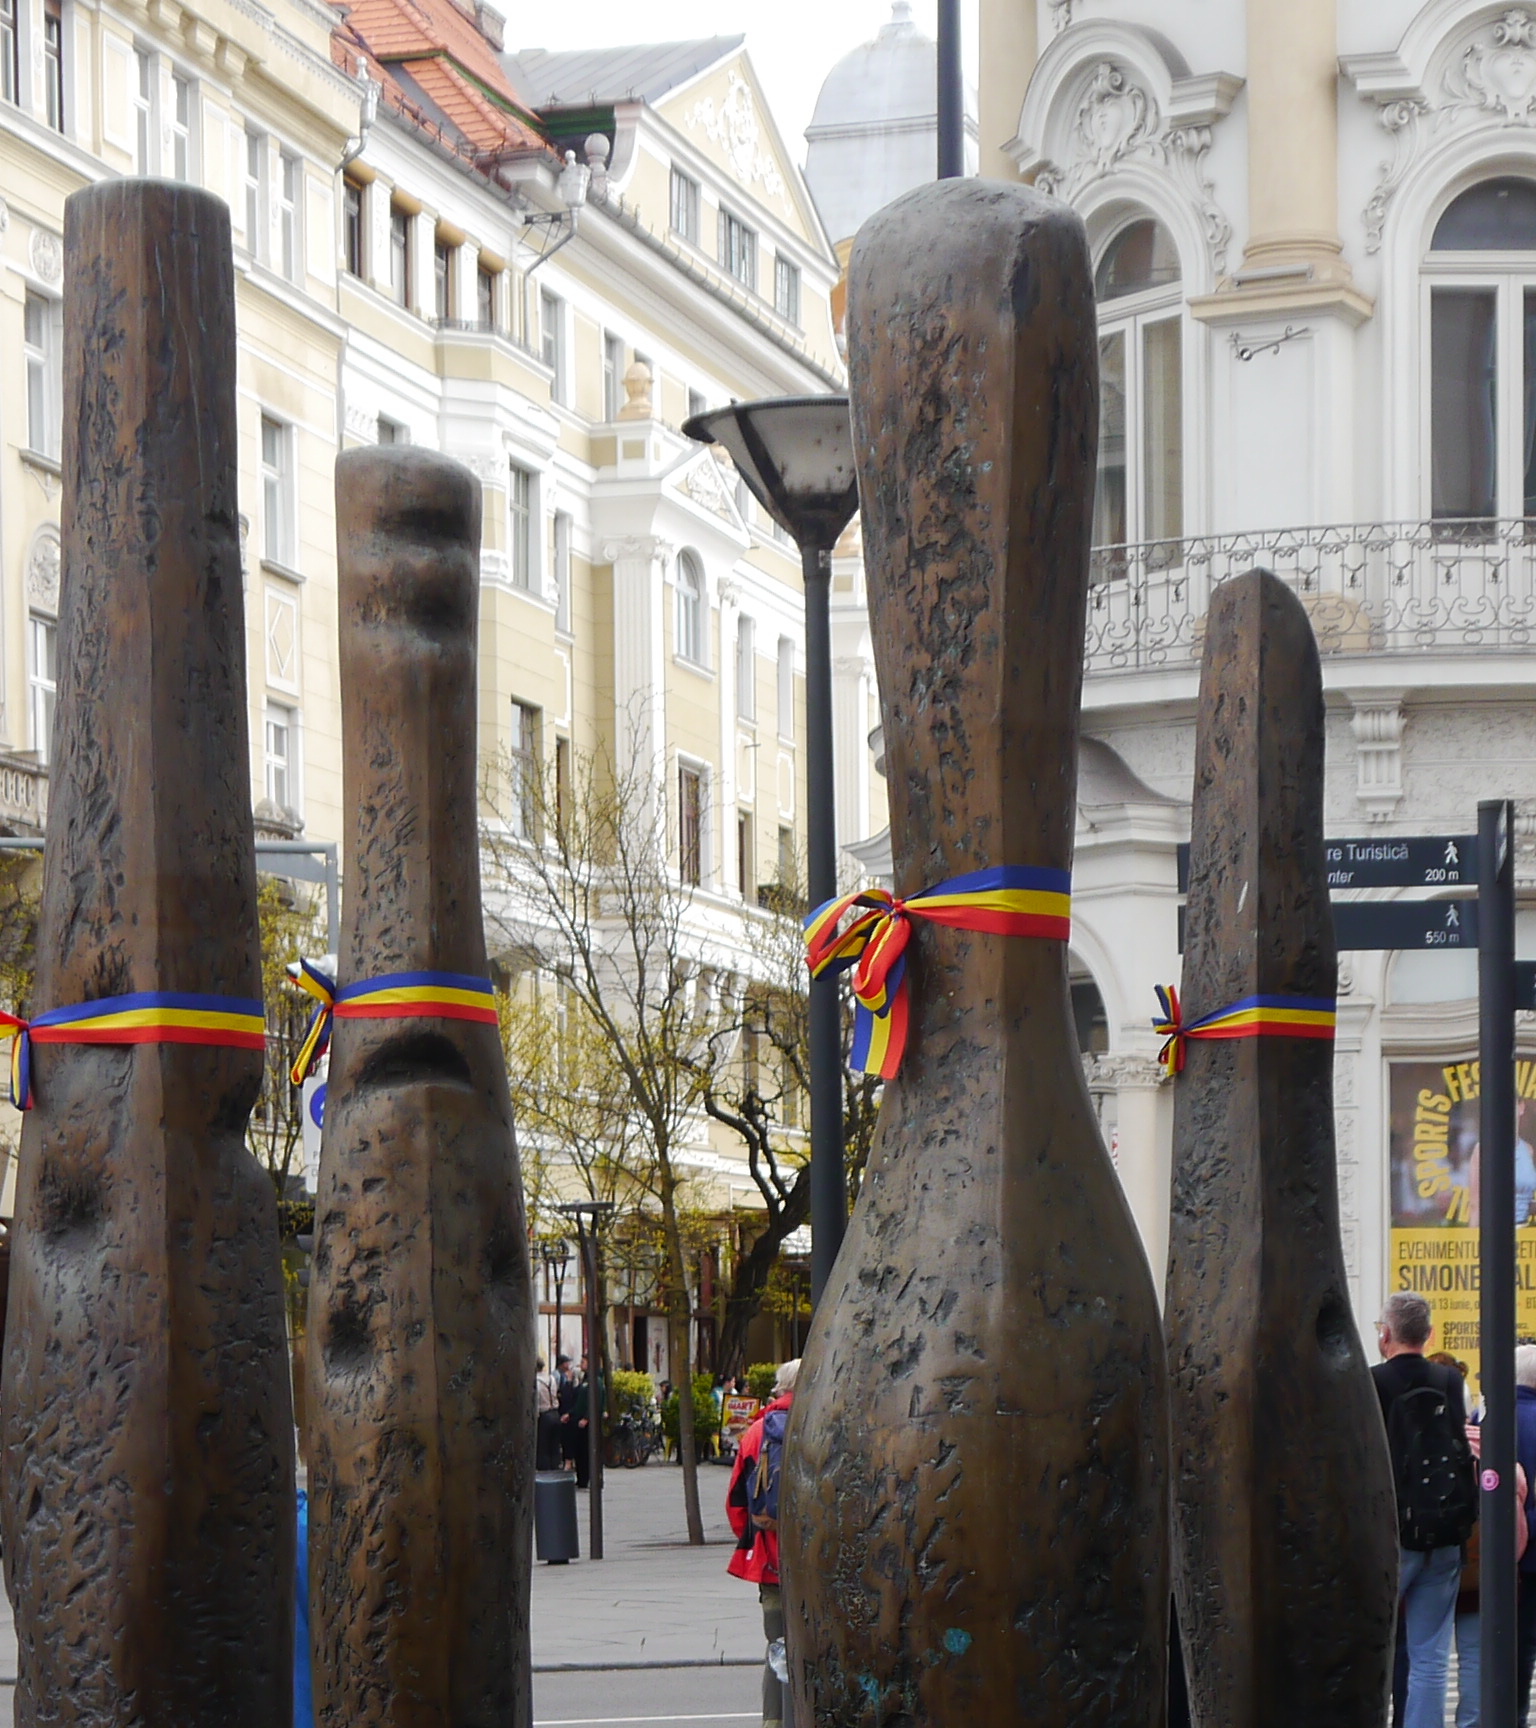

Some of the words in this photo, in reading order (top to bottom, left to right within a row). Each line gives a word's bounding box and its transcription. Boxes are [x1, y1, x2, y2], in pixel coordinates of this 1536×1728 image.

[1347, 843, 1408, 860] Turistică
[1425, 868, 1446, 882] 200
[1448, 871, 1459, 881] m
[1426, 931, 1447, 944] 550
[1449, 934, 1460, 943] m
[1414, 1088, 1453, 1198] SPORTS
[1399, 1240, 1480, 1260] EVENIMENTU
[1399, 1263, 1480, 1292] SIMONE
[1439, 1297, 1449, 1310] 13
[1450, 1297, 1473, 1312] iunie,
